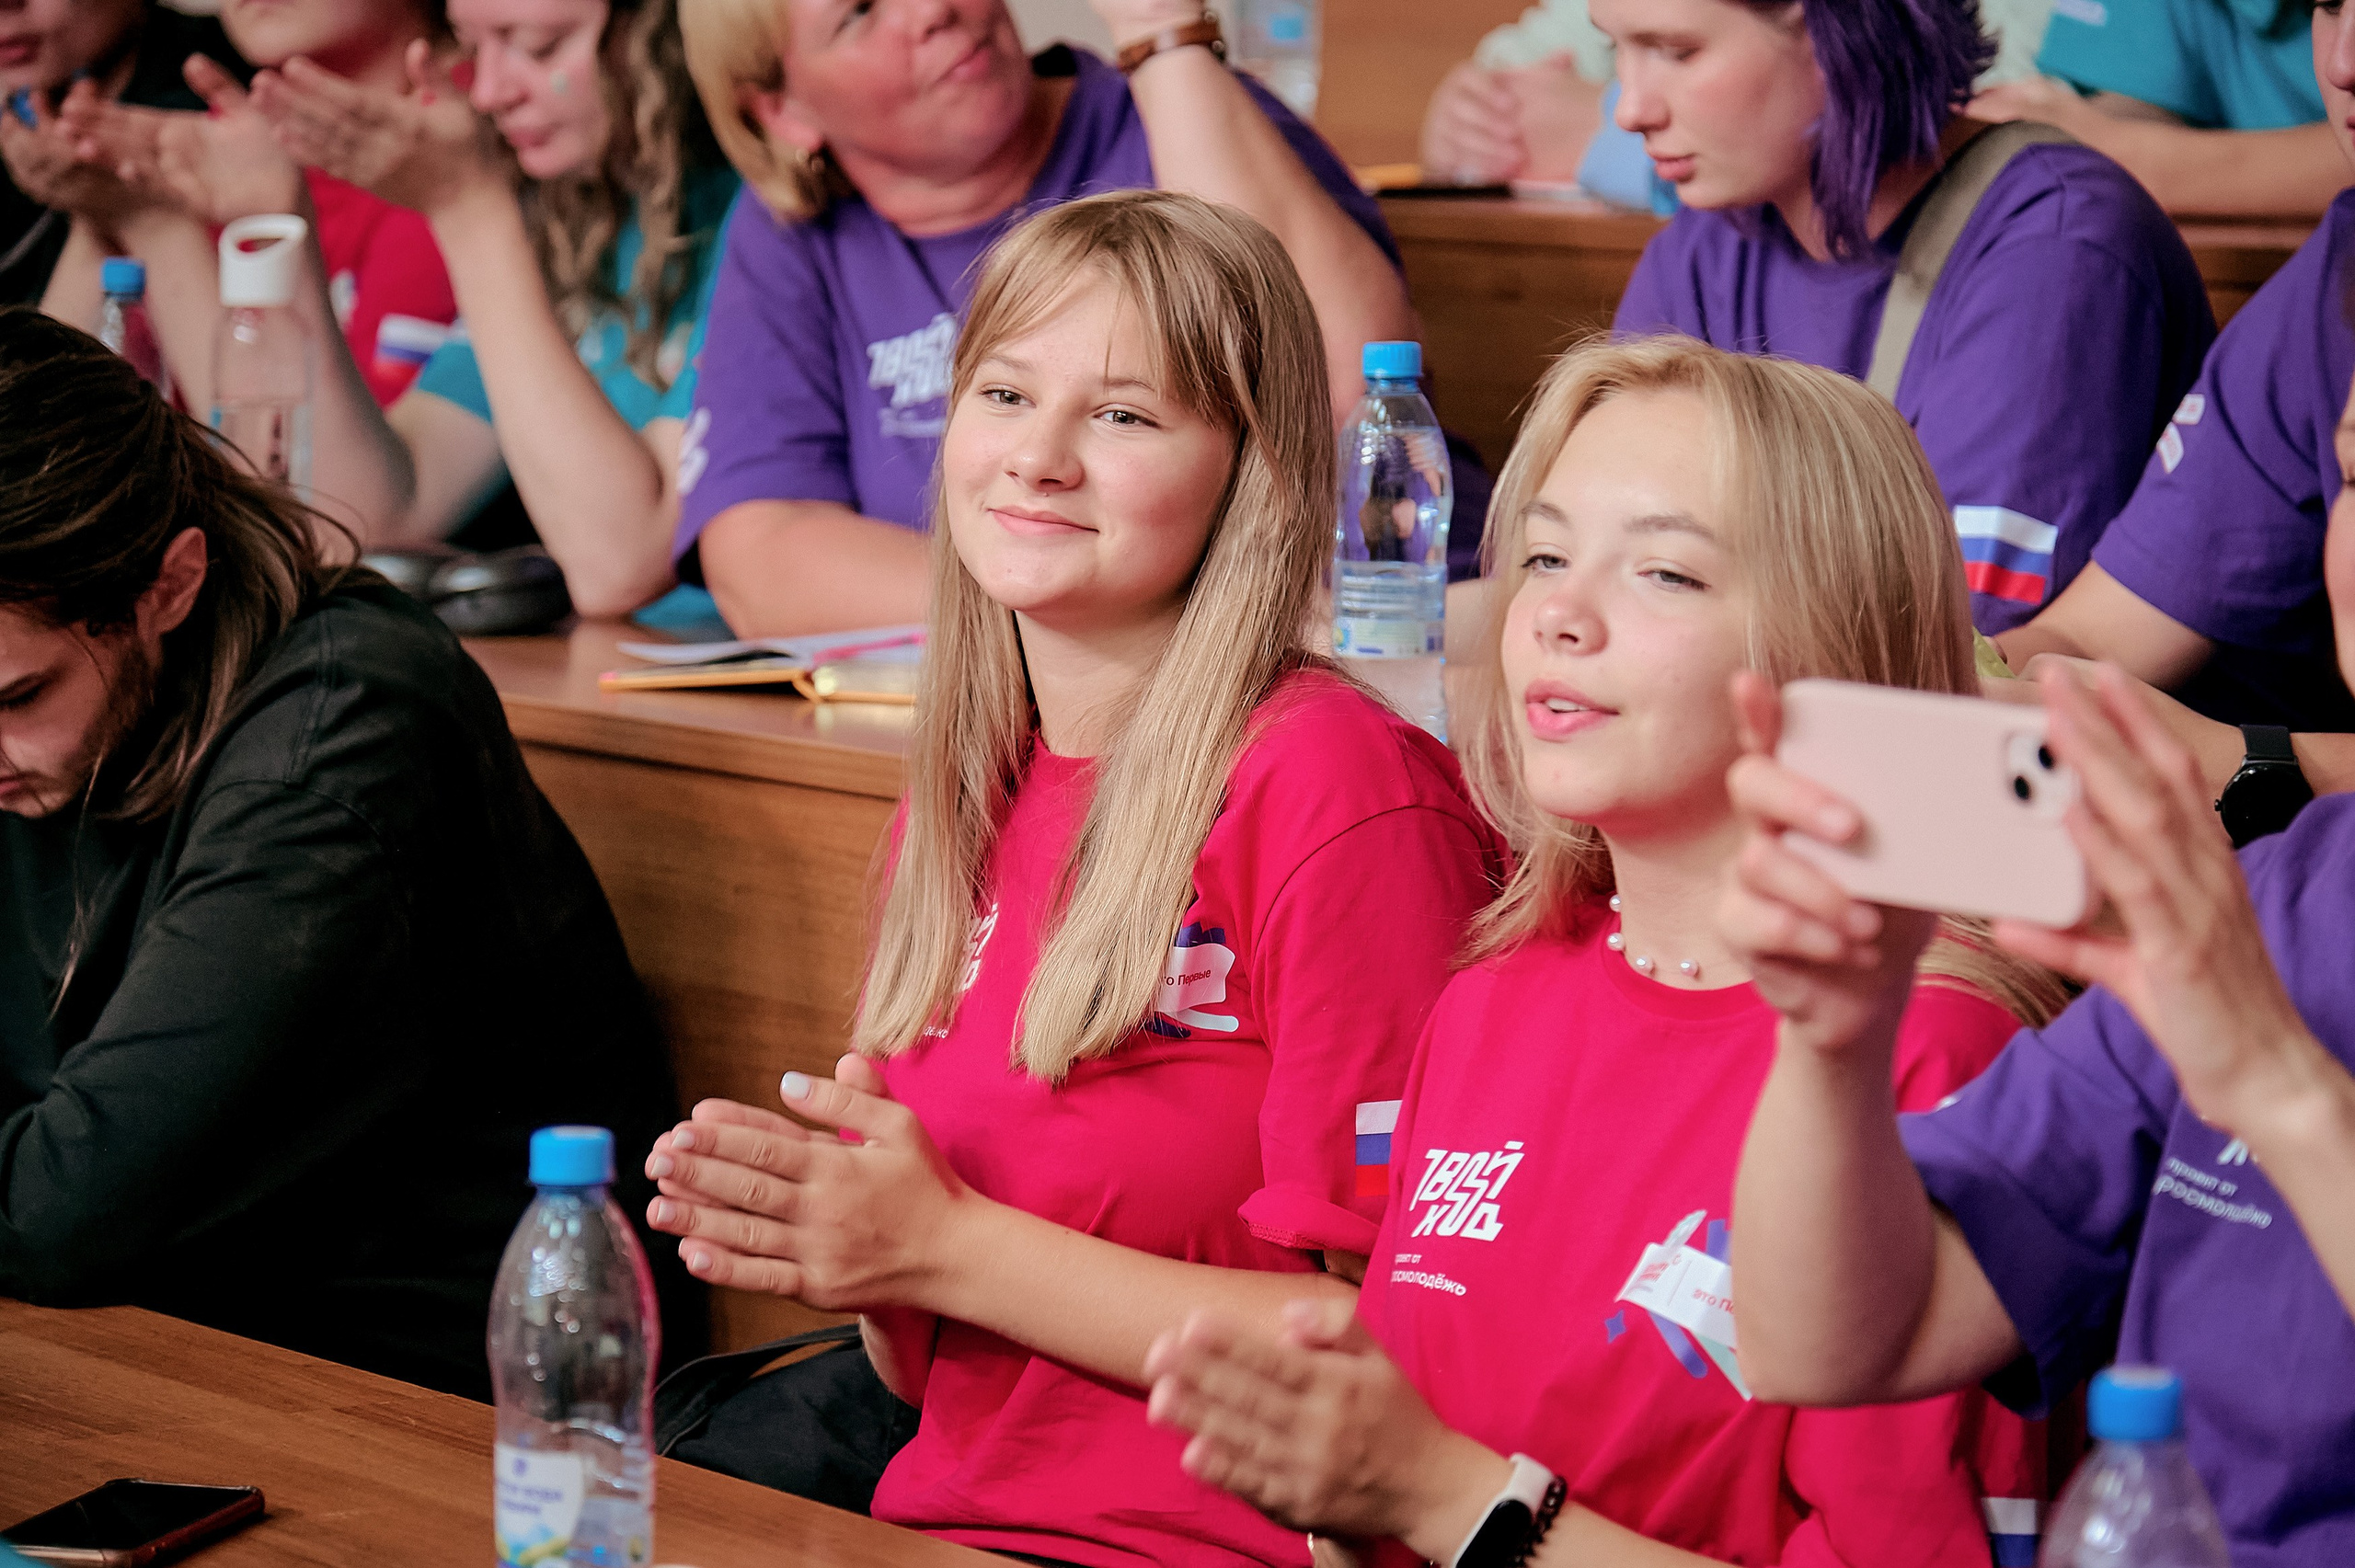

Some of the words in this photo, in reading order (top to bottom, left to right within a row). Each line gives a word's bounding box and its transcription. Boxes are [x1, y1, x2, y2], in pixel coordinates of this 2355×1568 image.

[1178, 969, 1212, 987] Первые
[1408, 1140, 1525, 1212] ТВОЙ
[1410, 1201, 1504, 1242] ХОД
